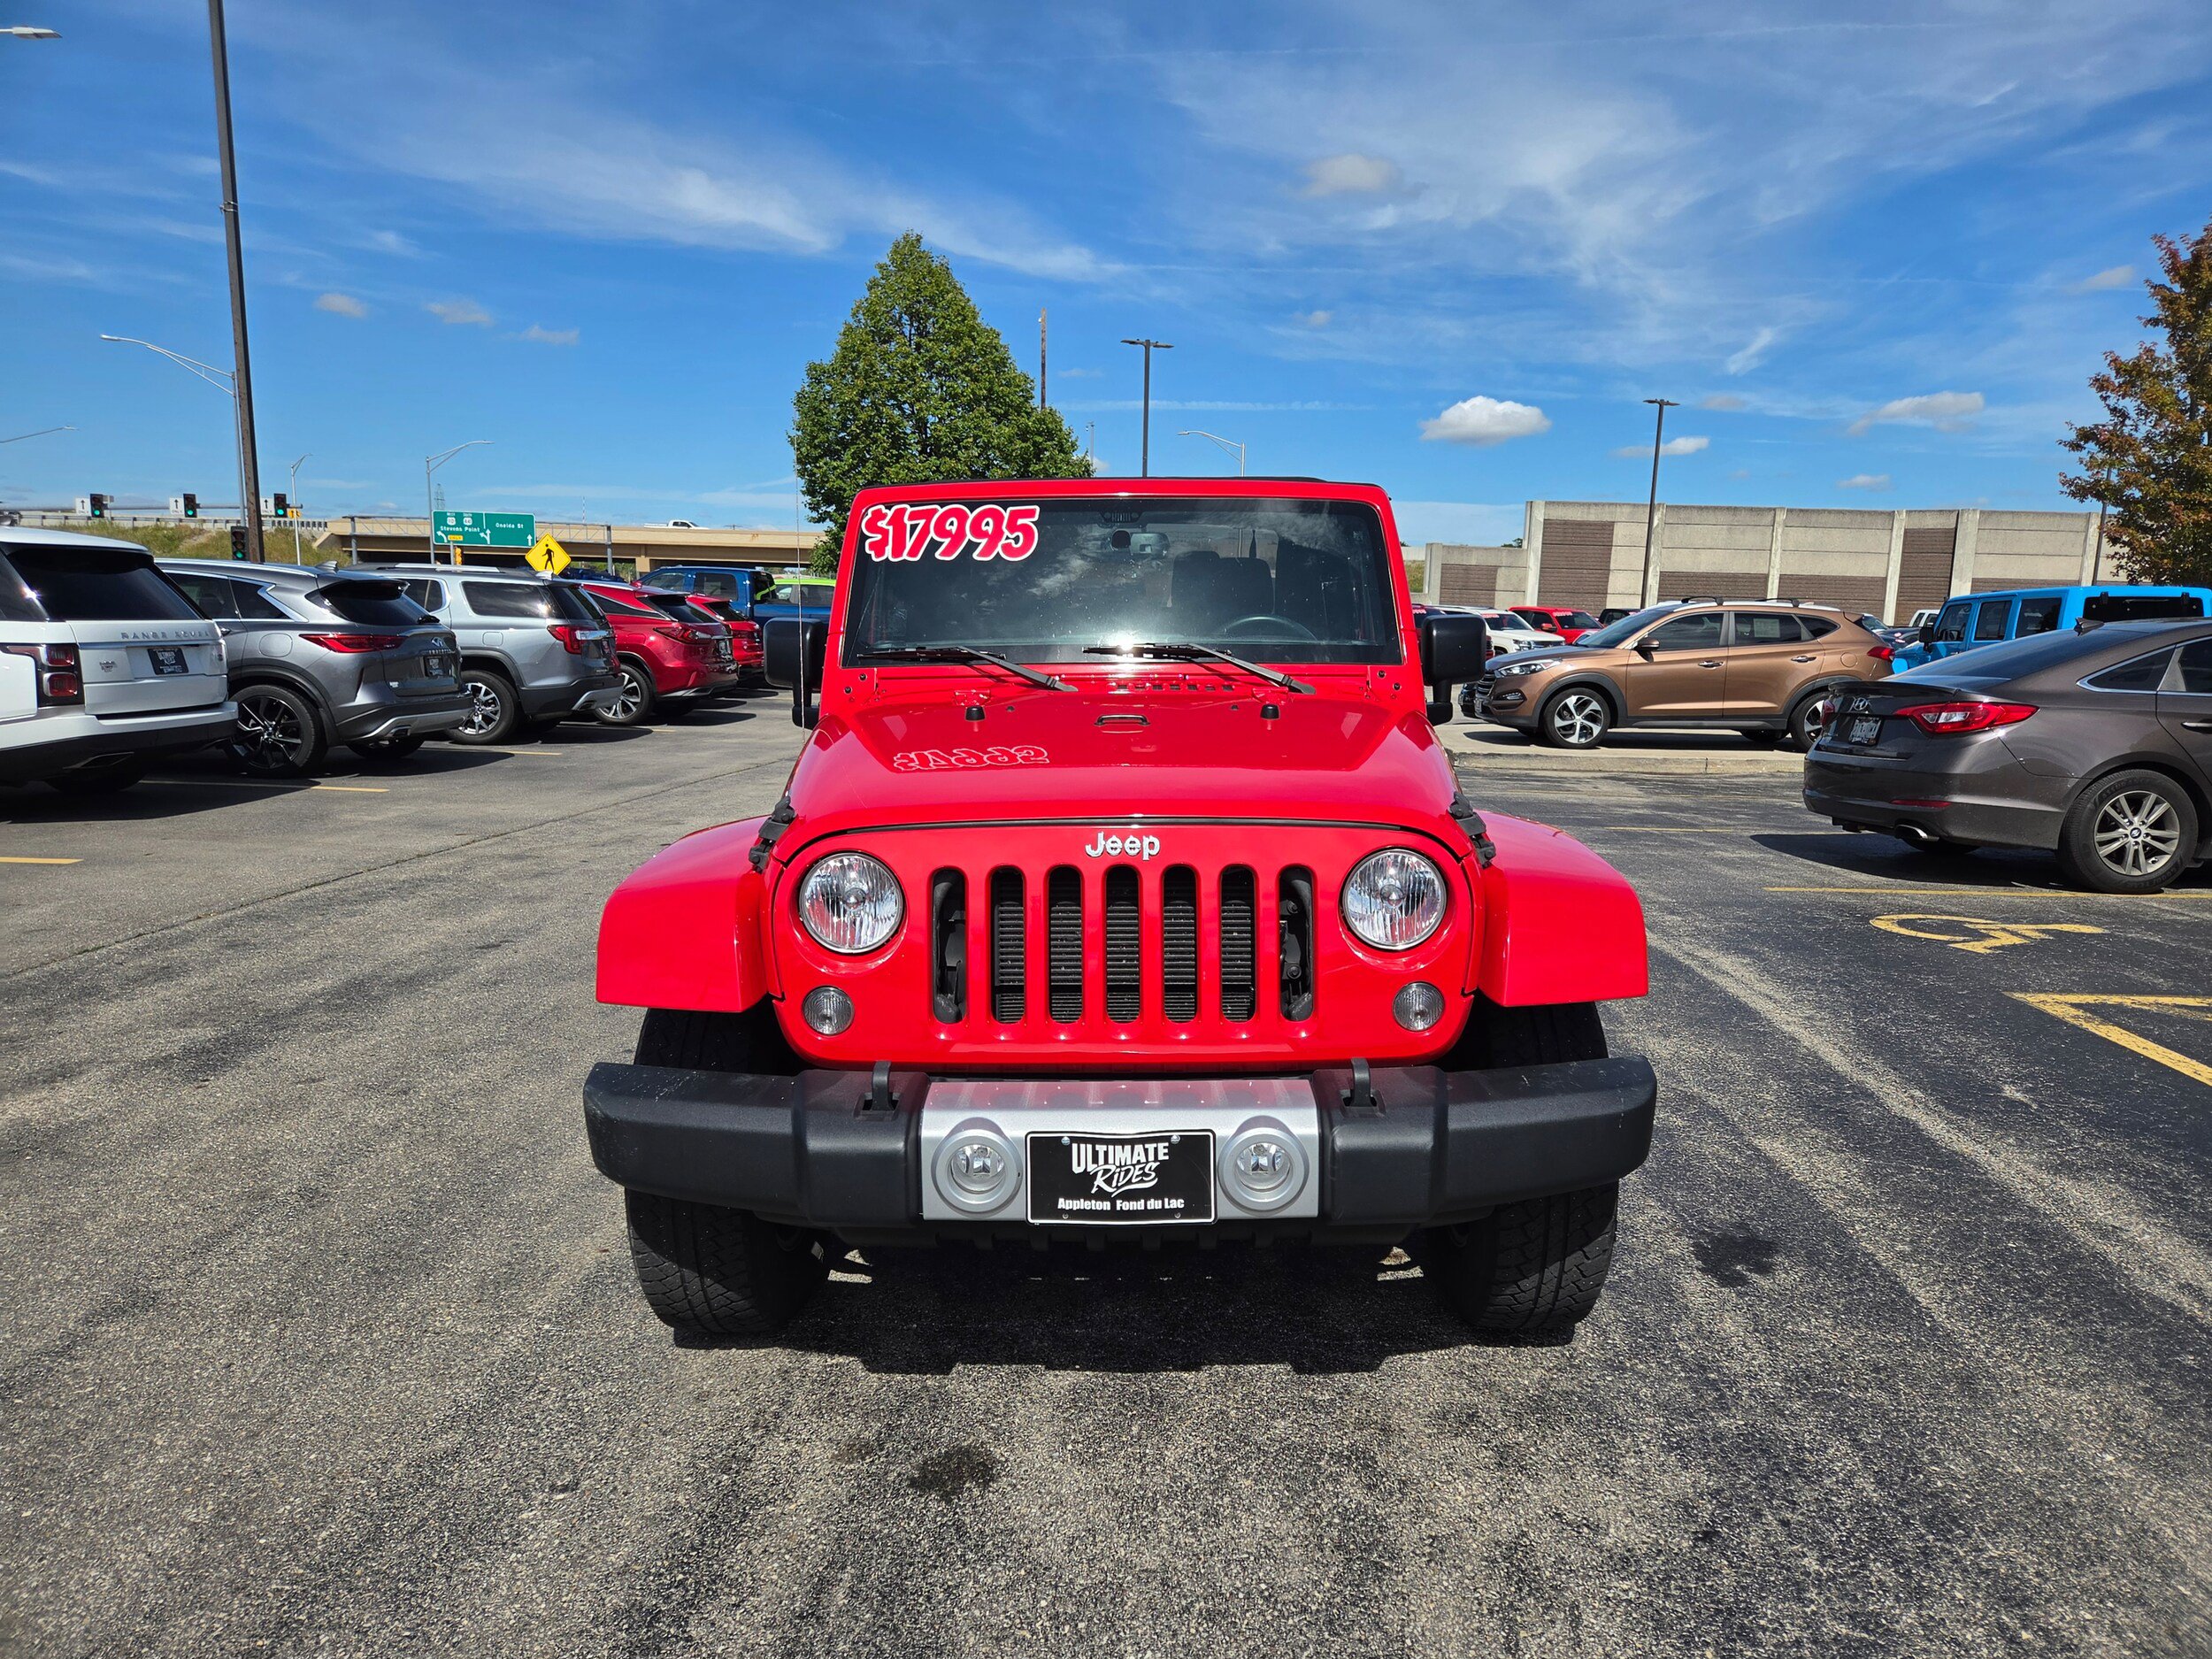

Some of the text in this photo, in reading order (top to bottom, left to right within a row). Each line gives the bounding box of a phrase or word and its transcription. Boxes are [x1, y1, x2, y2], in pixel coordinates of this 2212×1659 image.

[862, 504, 1040, 561] $17995
[1085, 831, 1160, 861] Jeep
[1071, 1142, 1169, 1174] ULTIMATE
[1057, 1197, 1185, 1210] Appleton Fond du Lac
